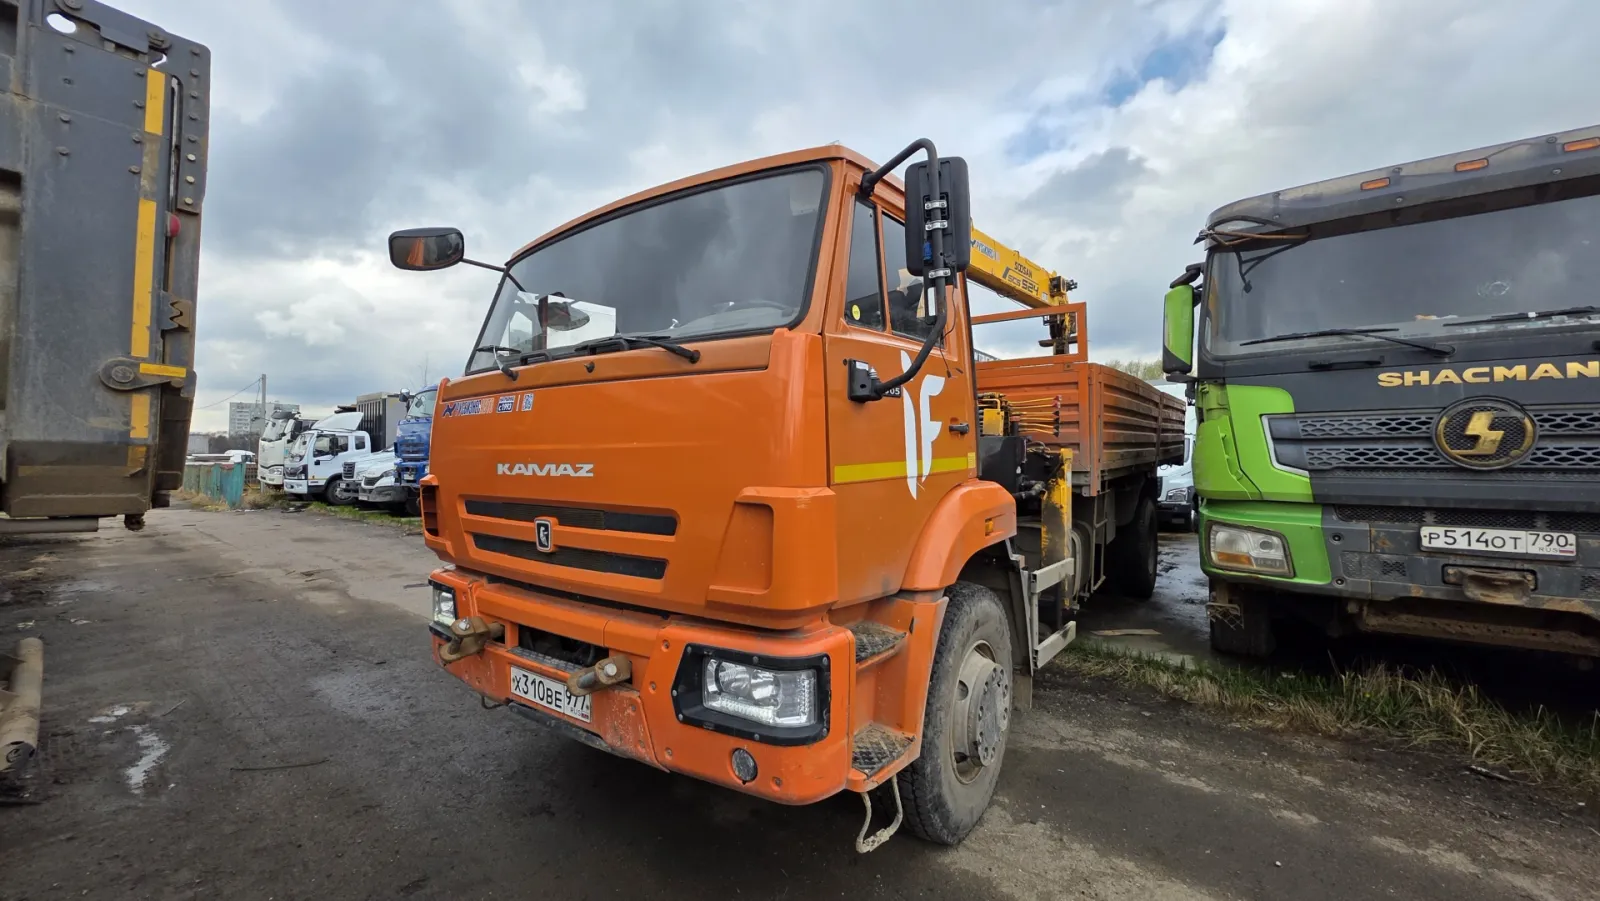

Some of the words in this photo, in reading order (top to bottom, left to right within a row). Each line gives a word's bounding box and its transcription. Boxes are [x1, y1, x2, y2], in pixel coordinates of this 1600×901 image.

[1377, 360, 1599, 388] SHACMAN
[496, 463, 594, 477] KAMAZ
[1427, 529, 1522, 551] Р514ОТ
[1528, 532, 1569, 547] 790
[514, 674, 562, 709] Х310ВЕ
